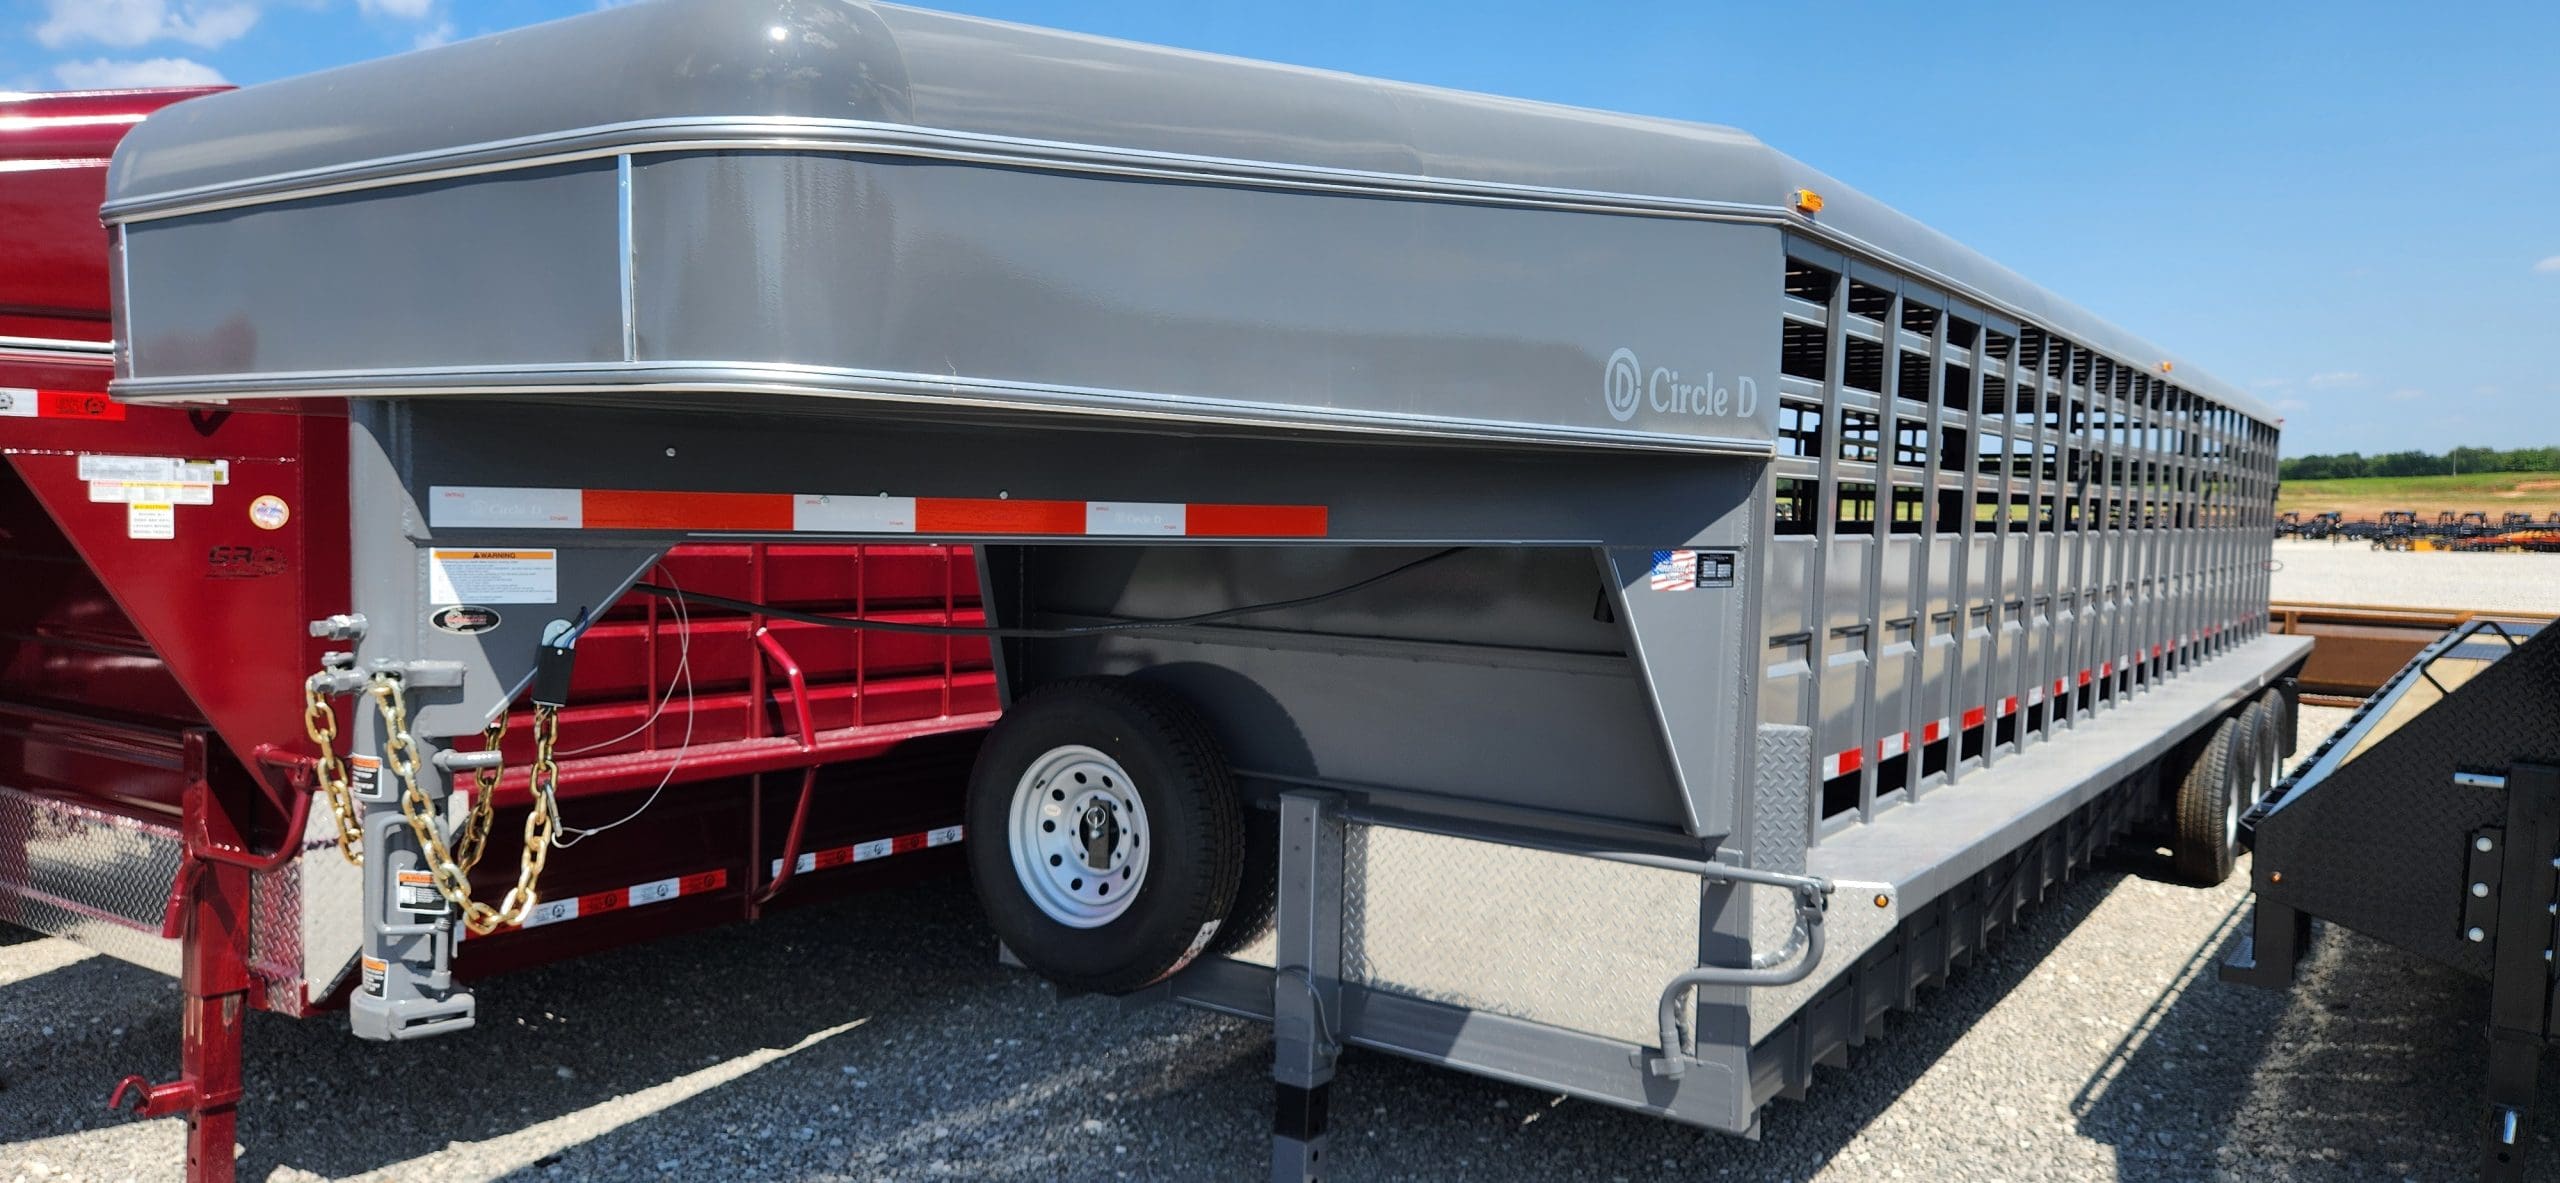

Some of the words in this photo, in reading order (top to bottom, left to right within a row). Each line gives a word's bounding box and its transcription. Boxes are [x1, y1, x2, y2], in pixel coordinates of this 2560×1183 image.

[1650, 366, 1728, 417] Circle
[1737, 376, 1758, 418] D
[480, 551, 516, 560] WARNING
